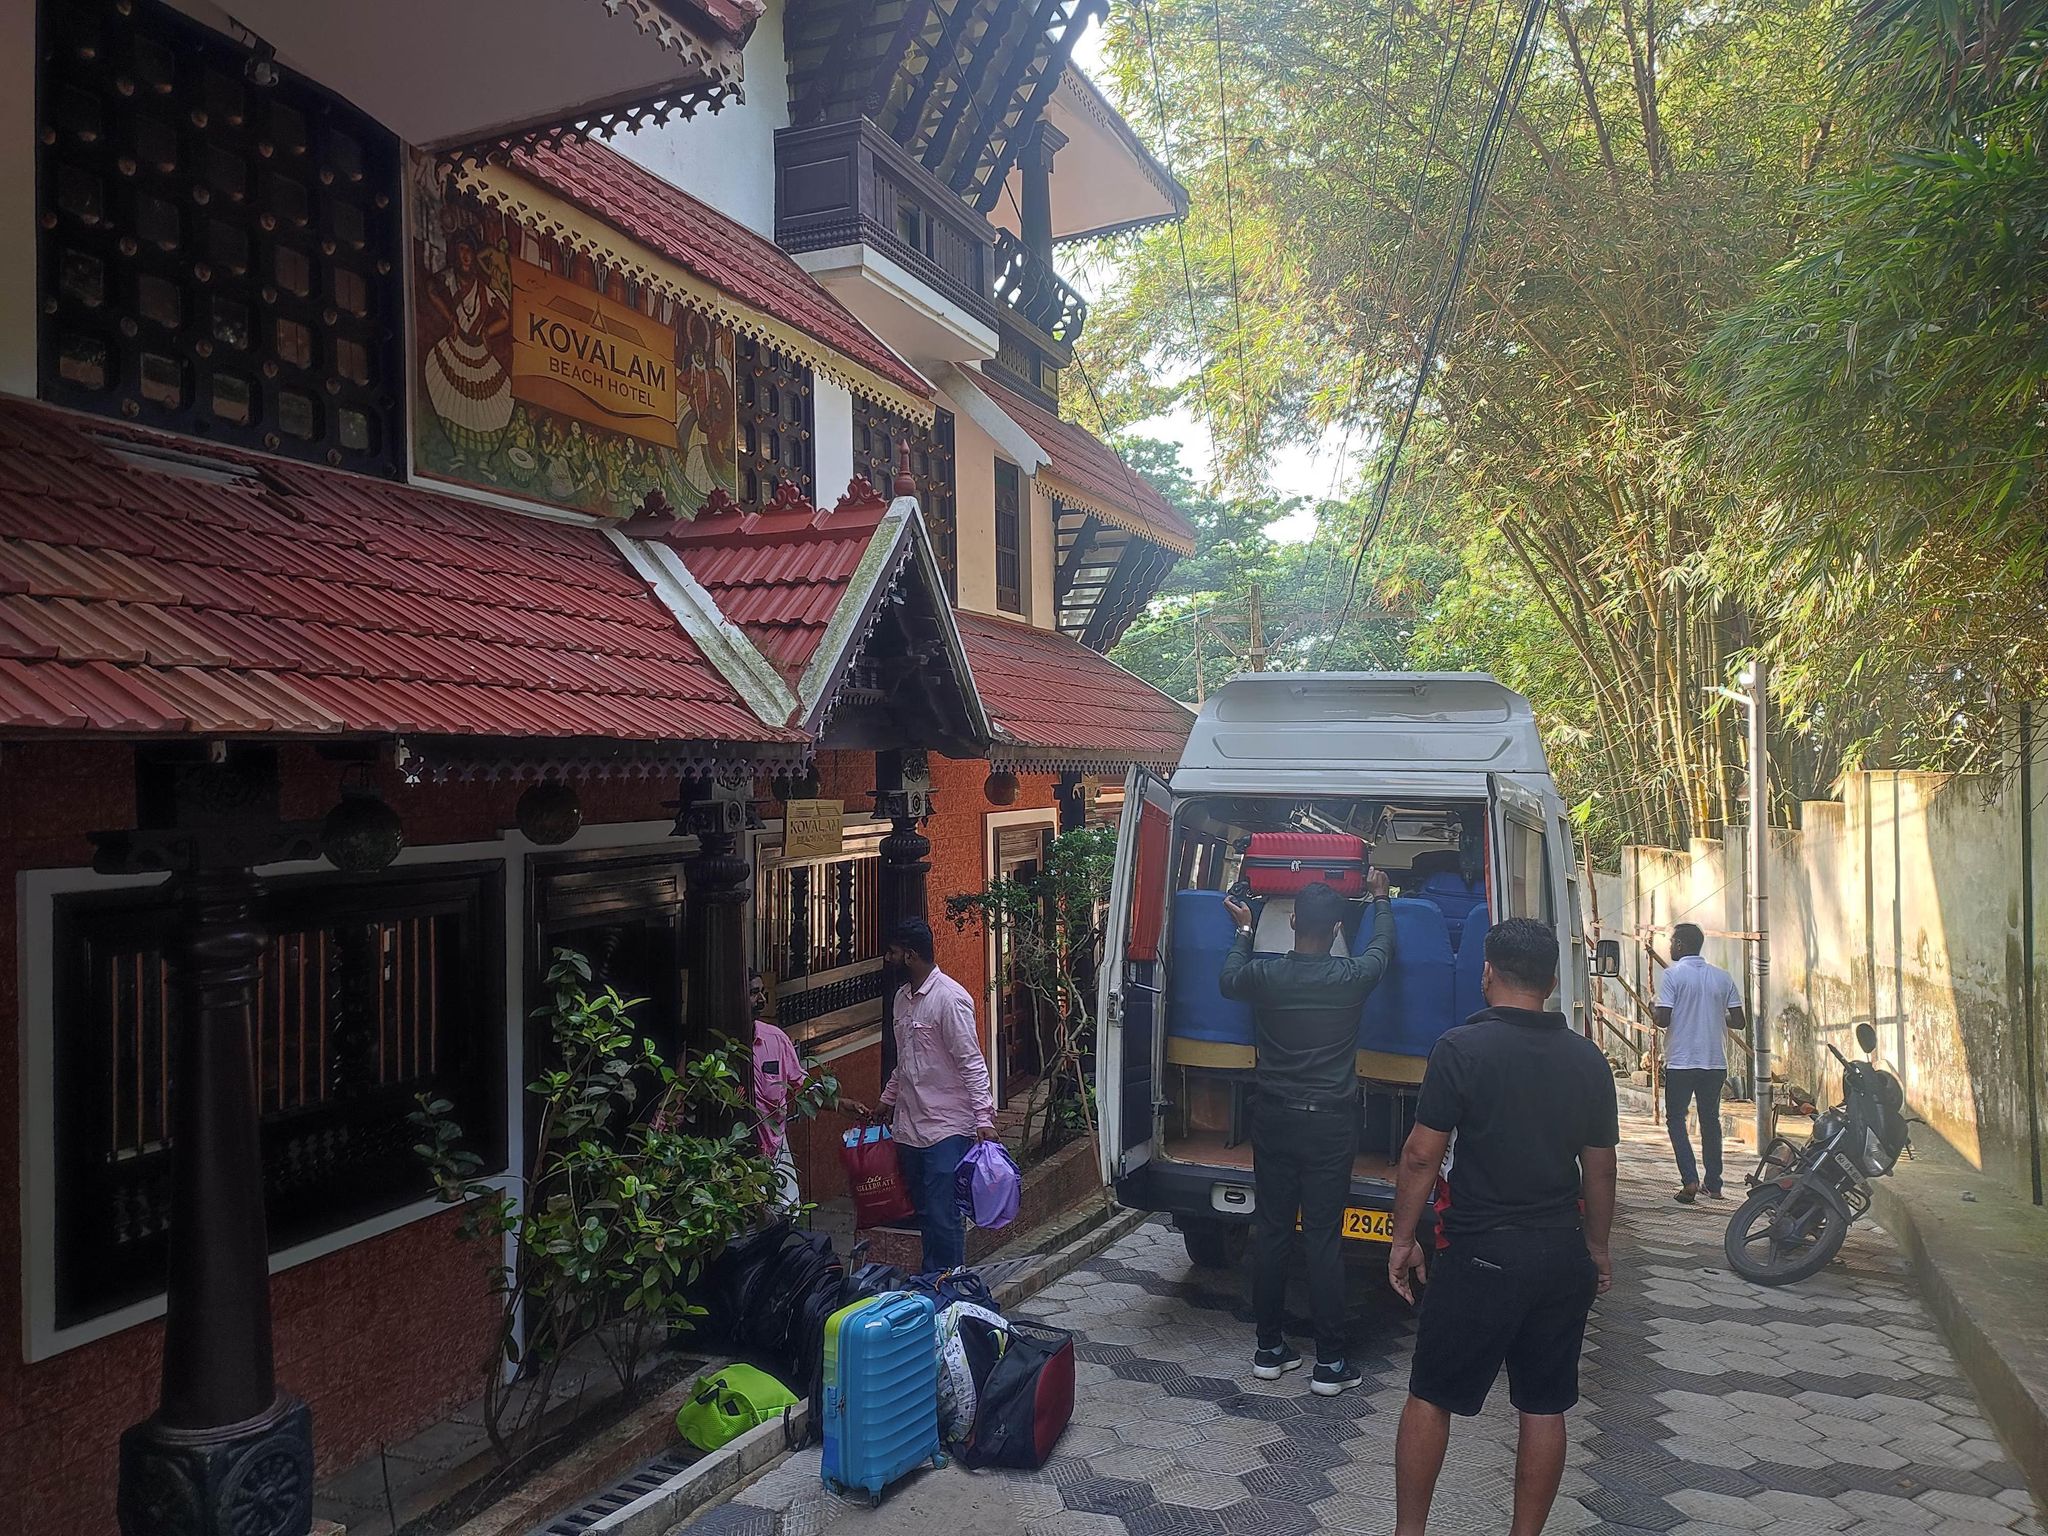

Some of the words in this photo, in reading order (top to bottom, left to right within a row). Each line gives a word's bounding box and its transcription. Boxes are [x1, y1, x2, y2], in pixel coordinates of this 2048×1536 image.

[529, 312, 665, 391] KOVALAM
[549, 357, 603, 388] BEACH
[609, 379, 655, 407] HOTEL
[790, 819, 840, 834] KOVALAM
